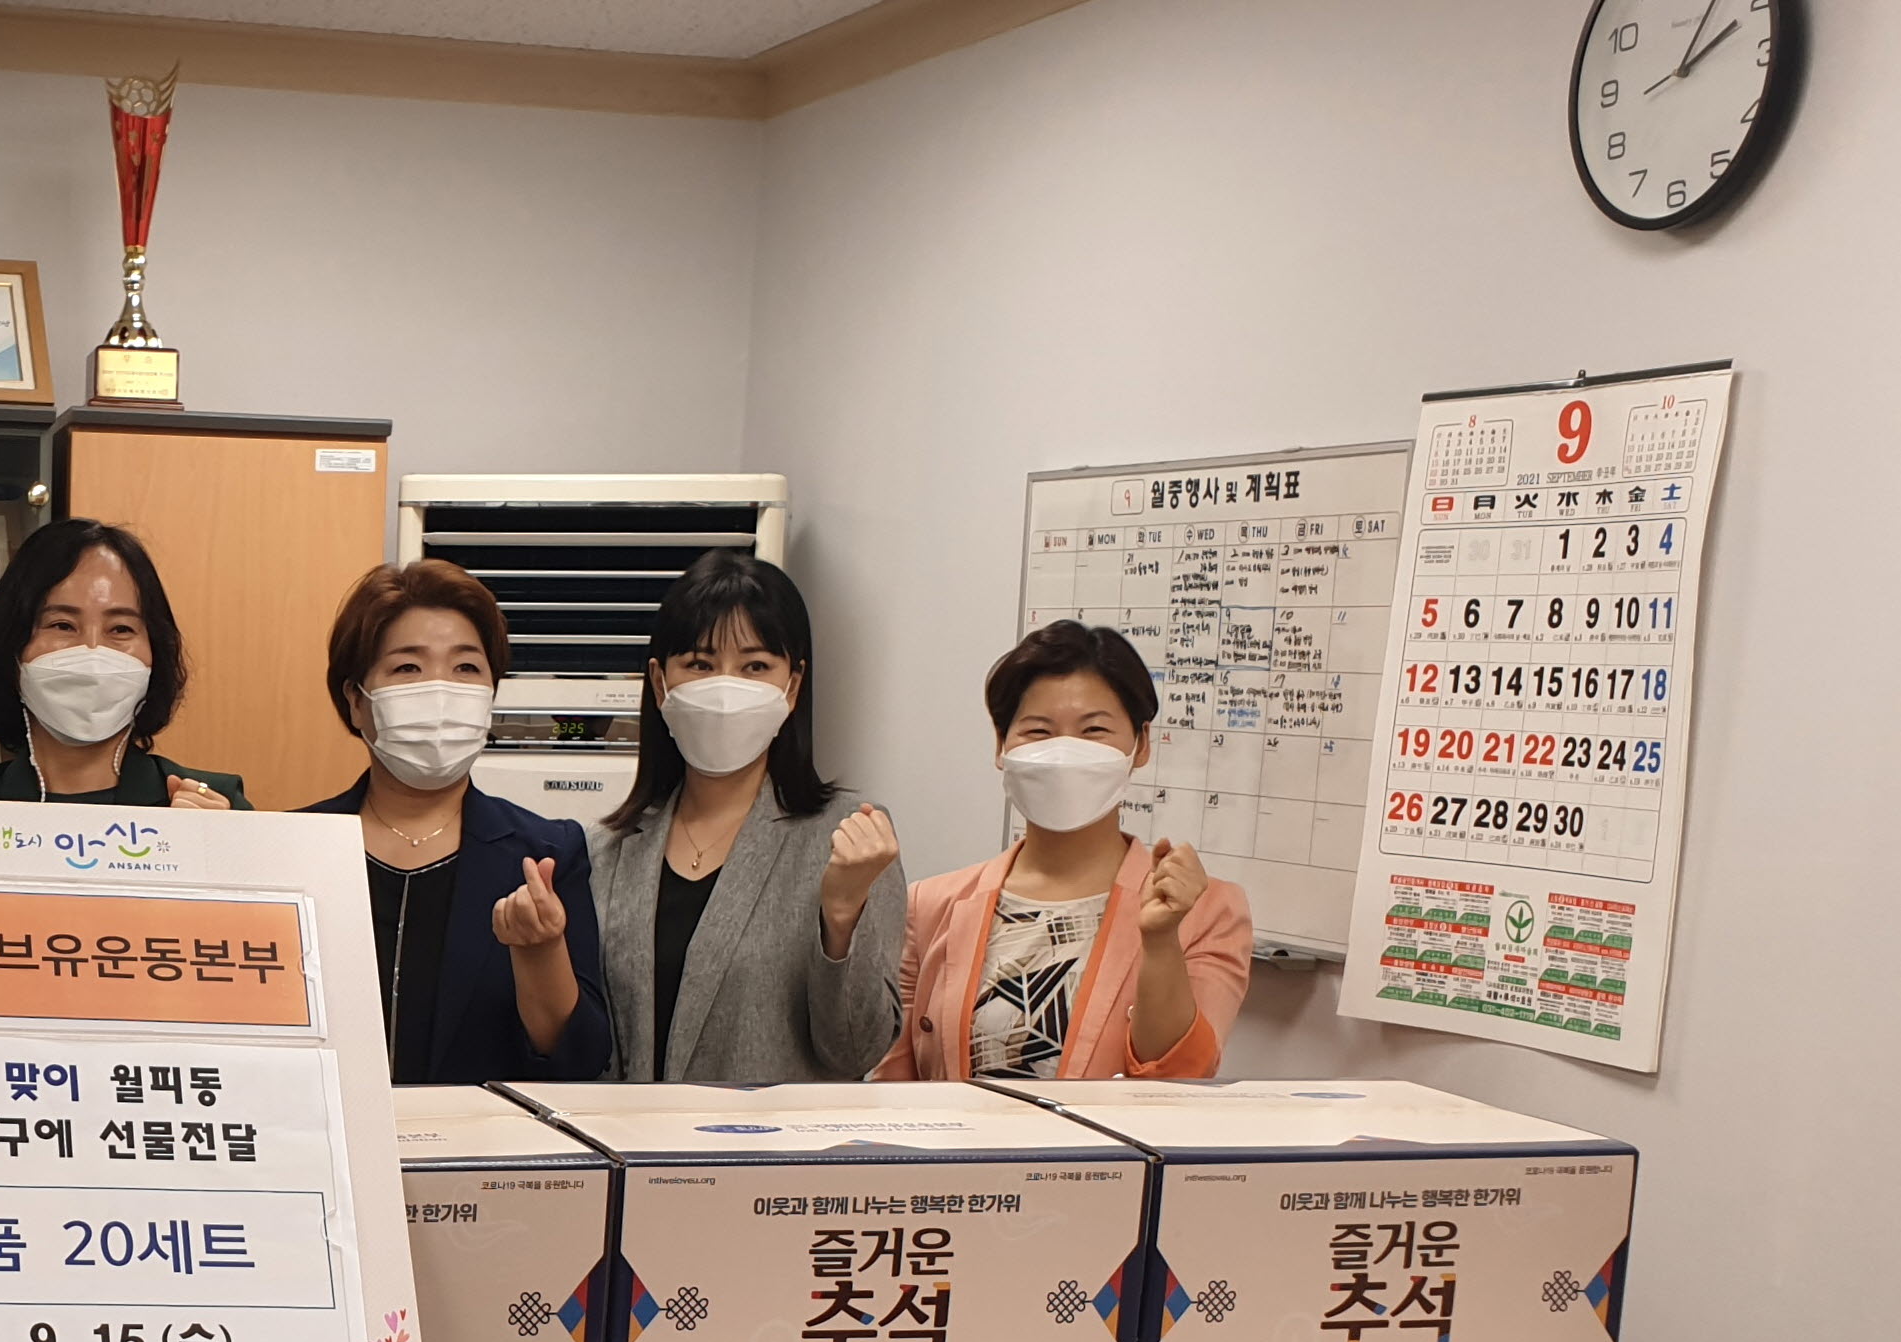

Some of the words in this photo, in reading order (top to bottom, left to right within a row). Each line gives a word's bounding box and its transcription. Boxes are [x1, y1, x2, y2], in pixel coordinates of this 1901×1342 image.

[1608, 22, 1638, 54] 10
[1600, 80, 1618, 108] 9
[1607, 132, 1625, 160] 8
[1629, 169, 1648, 198] 7
[1667, 180, 1686, 208] 6
[1557, 400, 1592, 464] 9
[1150, 475, 1220, 509] 월중행사
[1226, 483, 1238, 503] 및
[1245, 470, 1300, 500] 계획표
[1516, 473, 1541, 486] 2021
[1431, 496, 1454, 512] 日
[1473, 494, 1496, 511] 月
[1514, 493, 1539, 509] 火
[1556, 490, 1579, 507] 水
[1595, 489, 1614, 505] 木
[1628, 486, 1646, 503] 金
[1661, 483, 1681, 501] 土
[1517, 510, 1533, 519] TUE
[1558, 508, 1575, 517] WED
[1053, 536, 1067, 548] SUN
[1097, 534, 1116, 546] MON
[1148, 531, 1162, 543] TUE
[1197, 529, 1215, 541] WED
[1251, 525, 1268, 538] THU
[1309, 523, 1324, 536] FRI
[1367, 519, 1386, 533] SAT
[1558, 529, 1570, 559] 1
[1592, 527, 1607, 558] 2
[1626, 524, 1639, 557] 3
[1659, 523, 1673, 555] 4
[1421, 598, 1438, 628] 5
[1464, 599, 1480, 628] 6
[1507, 600, 1523, 629] 7
[1548, 598, 1563, 629] 8
[1586, 598, 1600, 629] 9
[1615, 597, 1639, 628] 10
[1649, 597, 1672, 629] 11
[1406, 663, 1438, 693] 12
[1449, 665, 1481, 695] 13
[1492, 666, 1522, 696] 14
[1533, 666, 1563, 697] 15
[1572, 667, 1598, 698] 16
[1607, 668, 1634, 700] 17
[1642, 669, 1666, 701] 18
[1398, 728, 1430, 757] 19
[1438, 729, 1473, 759] 20
[1483, 732, 1515, 763] 21
[1522, 734, 1555, 766] 22
[1561, 736, 1591, 768] 23
[1597, 739, 1626, 771] 24
[1632, 741, 1661, 773] 25
[543, 779, 604, 791] SAMSUNG
[1387, 792, 1423, 821] 26
[1430, 796, 1467, 826] 27
[1473, 799, 1508, 829] 28
[1516, 802, 1548, 833] 29
[1554, 805, 1583, 837] 30
[108, 862, 151, 871] ANSAN
[154, 864, 178, 872] CITY
[4, 1062, 80, 1102] 맞이
[109, 1064, 223, 1108] 월피동
[99, 1119, 257, 1163] 선물전달
[753, 1197, 809, 1217] 이웃과
[812, 1196, 849, 1216] 함께
[852, 1196, 906, 1216] 나누는
[910, 1195, 965, 1215] 행복한
[968, 1193, 1021, 1214] 한가위
[61, 1219, 256, 1276] 20세트
[808, 1226, 954, 1279] 즐거운
[1328, 1219, 1461, 1271] 즐거운
